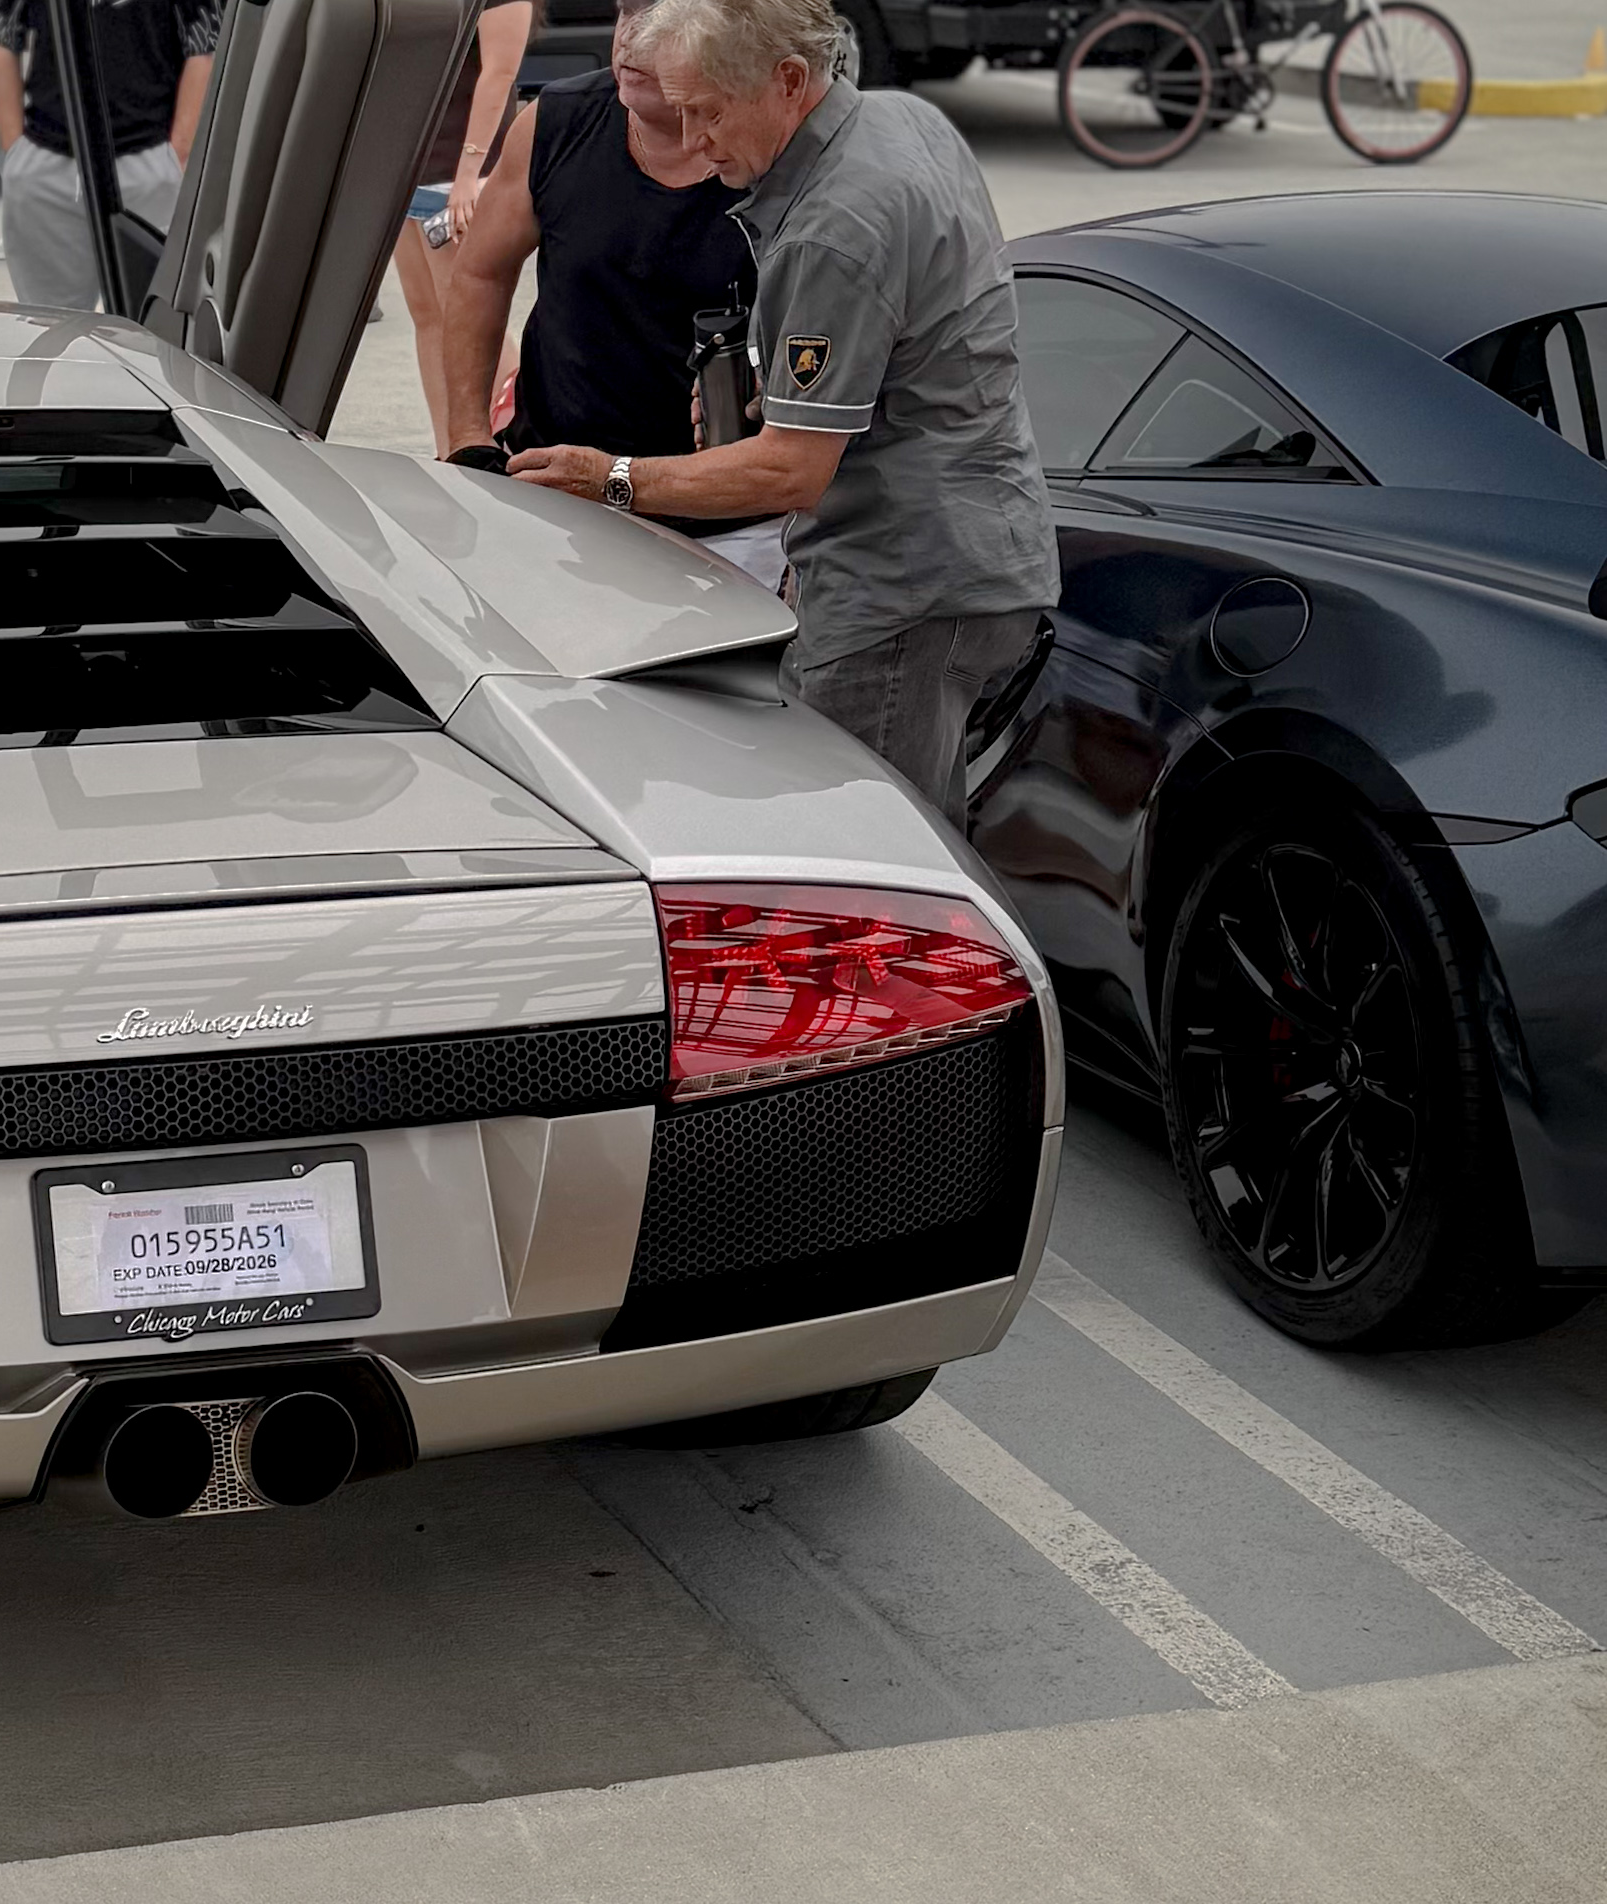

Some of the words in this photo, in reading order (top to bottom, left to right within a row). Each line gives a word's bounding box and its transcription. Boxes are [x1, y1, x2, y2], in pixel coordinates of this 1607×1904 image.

[97, 1004, 314, 1044] Lamborghini
[130, 1223, 287, 1259] 015955A51
[113, 1268, 142, 1282] EXP
[185, 1253, 277, 1276] 09/28/2026
[127, 1308, 196, 1339] Chicago
[201, 1305, 260, 1328] Motor
[262, 1299, 305, 1322] Cars
